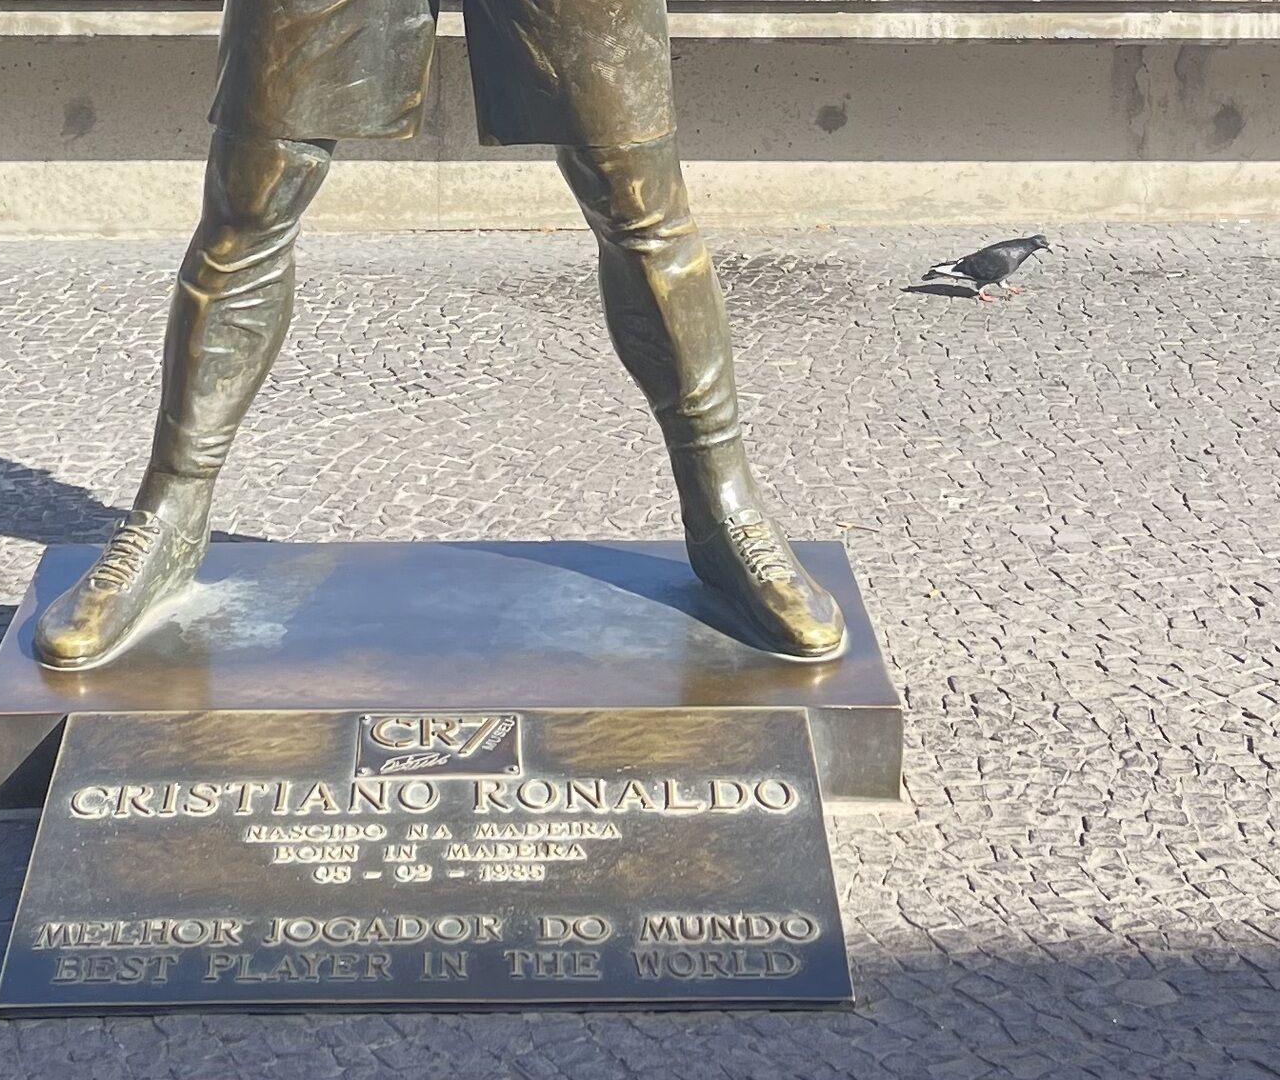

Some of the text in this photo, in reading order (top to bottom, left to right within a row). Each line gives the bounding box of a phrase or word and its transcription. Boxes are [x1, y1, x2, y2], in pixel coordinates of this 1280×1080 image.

[370, 716, 502, 755] CR7
[481, 714, 516, 752] MUSEU
[70, 778, 801, 819] CRISTIANO RONALDO
[245, 821, 622, 842] NASCIDO NA MADEIRA
[272, 841, 587, 863] BORN IN MADEIRA
[312, 865, 351, 883] 05
[478, 864, 546, 881] 1985
[32, 914, 821, 950] MELHOR JOGADOR DO MUNDO
[50, 949, 803, 985] BEST PLAYER IN THE WORLD
